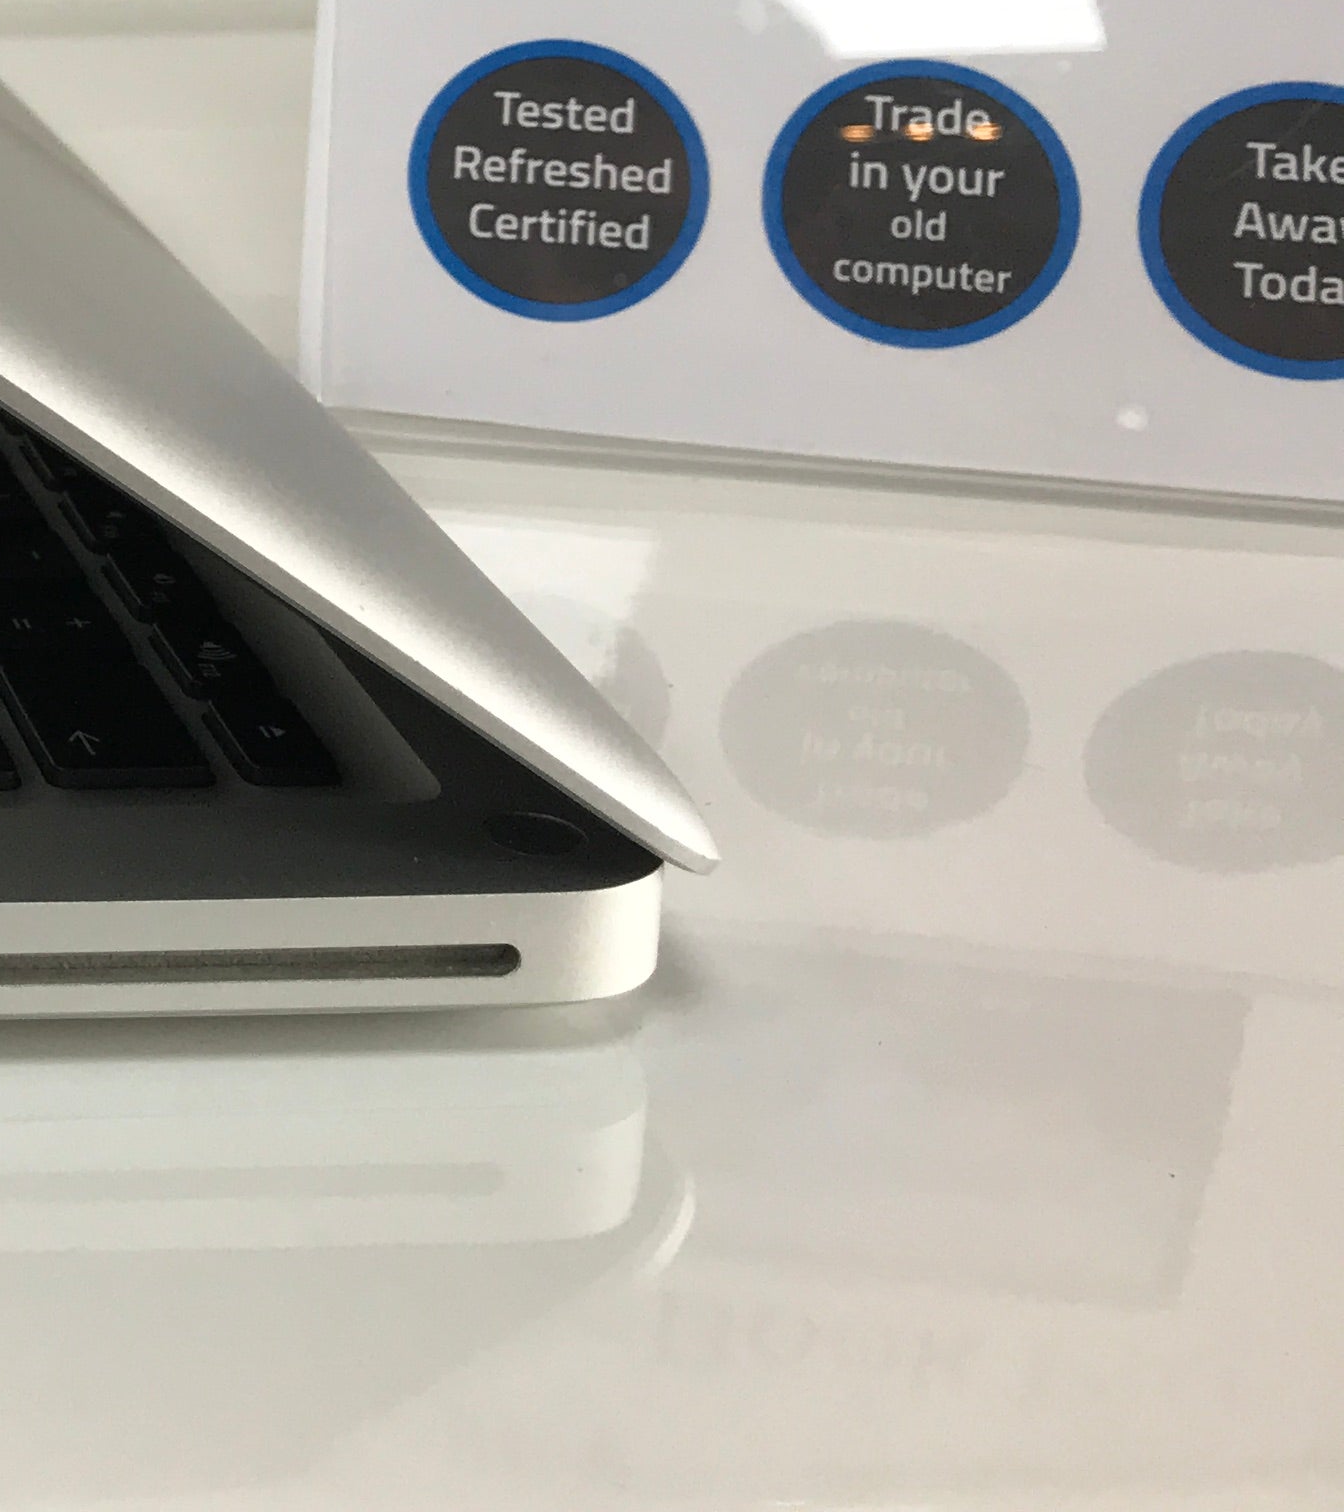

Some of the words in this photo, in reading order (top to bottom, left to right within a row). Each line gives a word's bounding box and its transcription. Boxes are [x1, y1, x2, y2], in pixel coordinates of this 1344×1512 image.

[493, 91, 637, 136] Tested
[864, 94, 994, 140] Trade
[451, 144, 673, 196] Refreshed
[849, 150, 889, 189] in
[901, 163, 1007, 203] your
[467, 202, 651, 252] Certified
[891, 208, 948, 242] old
[1233, 201, 1344, 245] Awa
[831, 259, 1013, 297] computer
